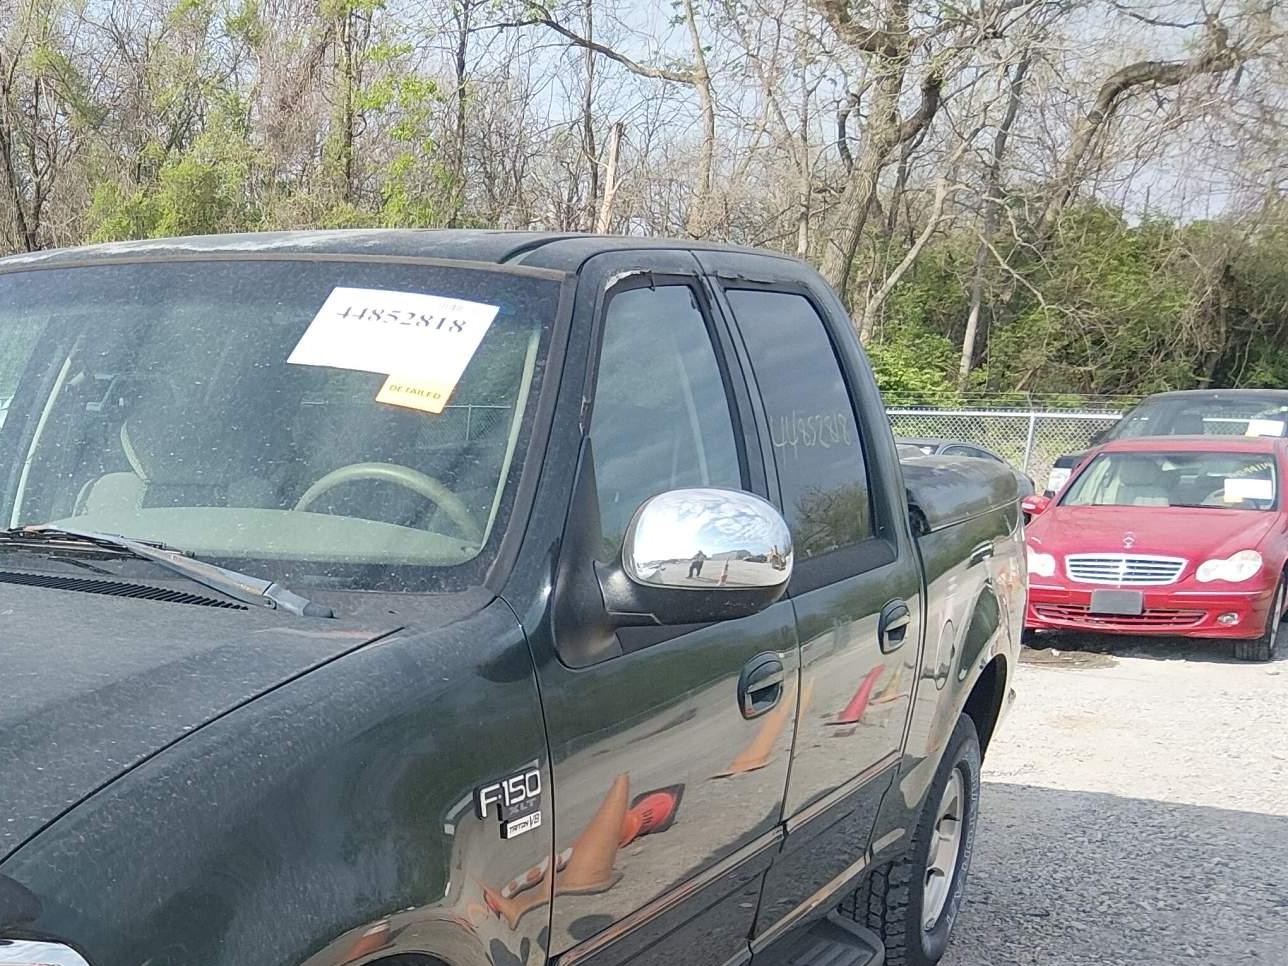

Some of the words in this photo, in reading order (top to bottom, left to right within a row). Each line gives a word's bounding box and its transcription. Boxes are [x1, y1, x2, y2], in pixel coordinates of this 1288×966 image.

[337, 306, 468, 333] 44852818
[388, 384, 441, 400] DETAILED
[509, 799, 536, 815] XLT
